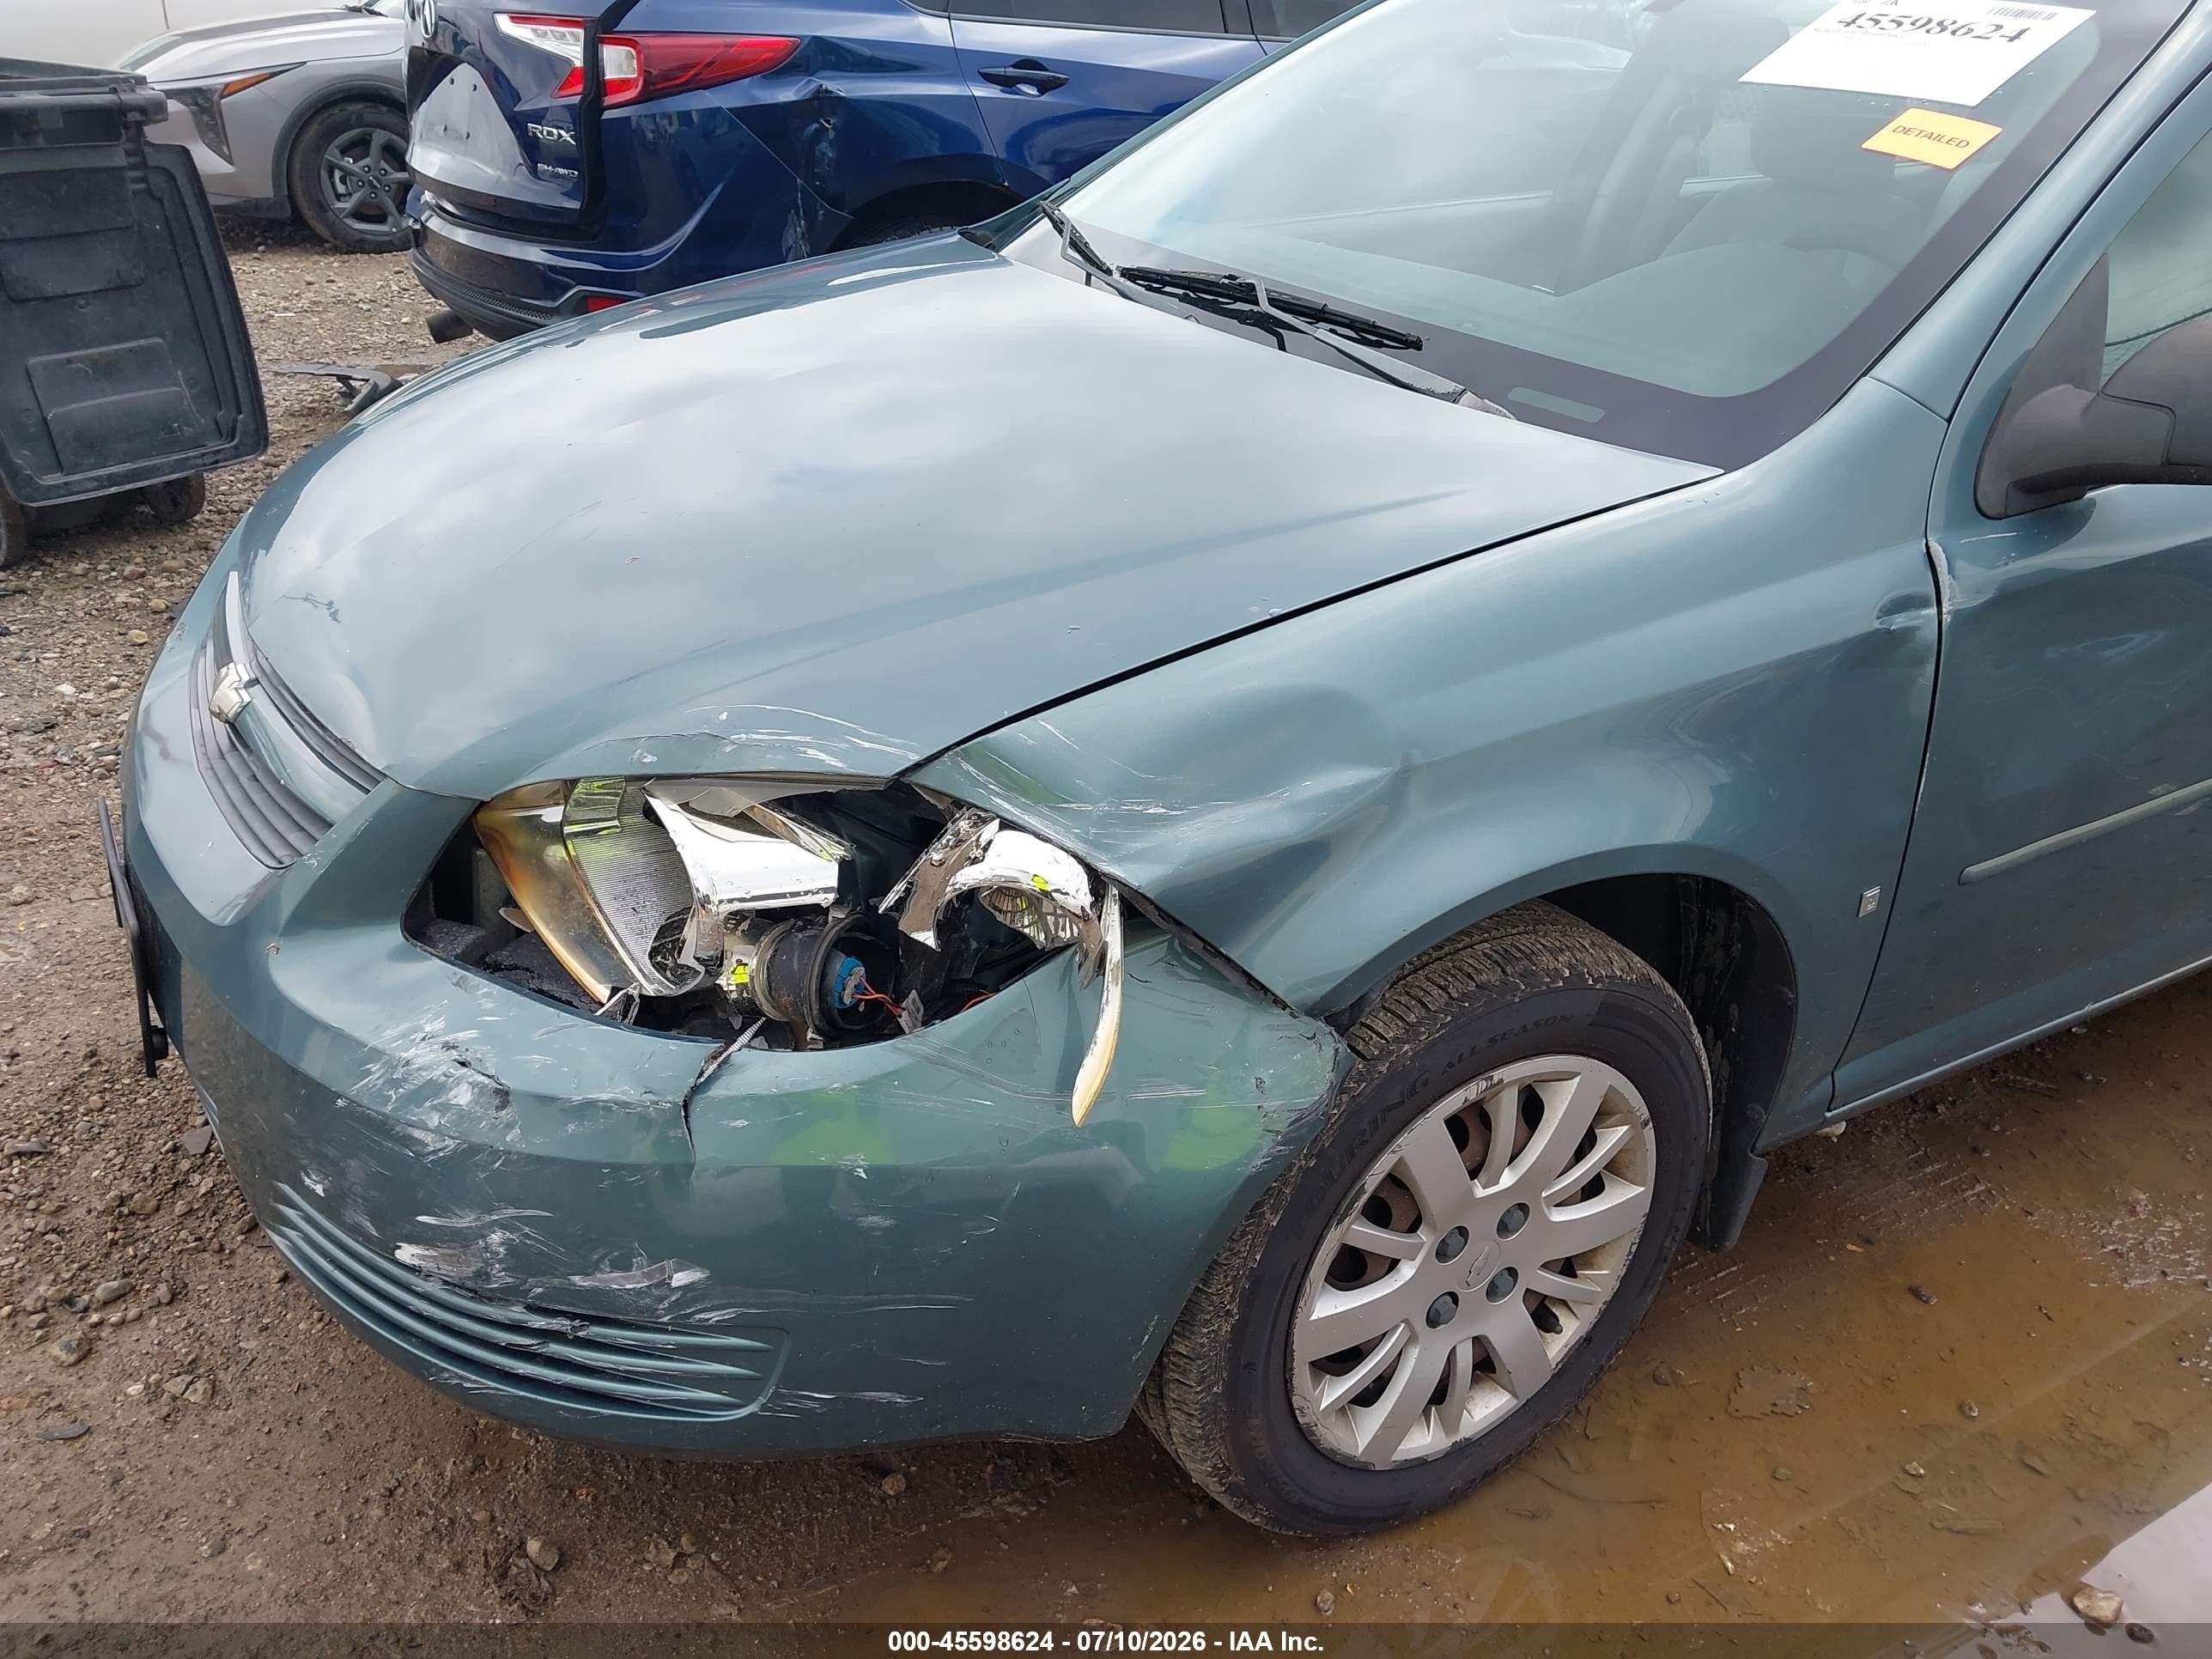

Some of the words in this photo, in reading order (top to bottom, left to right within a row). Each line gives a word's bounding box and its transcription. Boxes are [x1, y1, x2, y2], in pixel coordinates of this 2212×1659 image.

[1838, 11, 2032, 43] 45598624
[527, 123, 576, 145] RDX
[1892, 125, 1970, 149] DETAILED
[1442, 1044, 1483, 1075] ALL
[1487, 1013, 1573, 1045] SEASON
